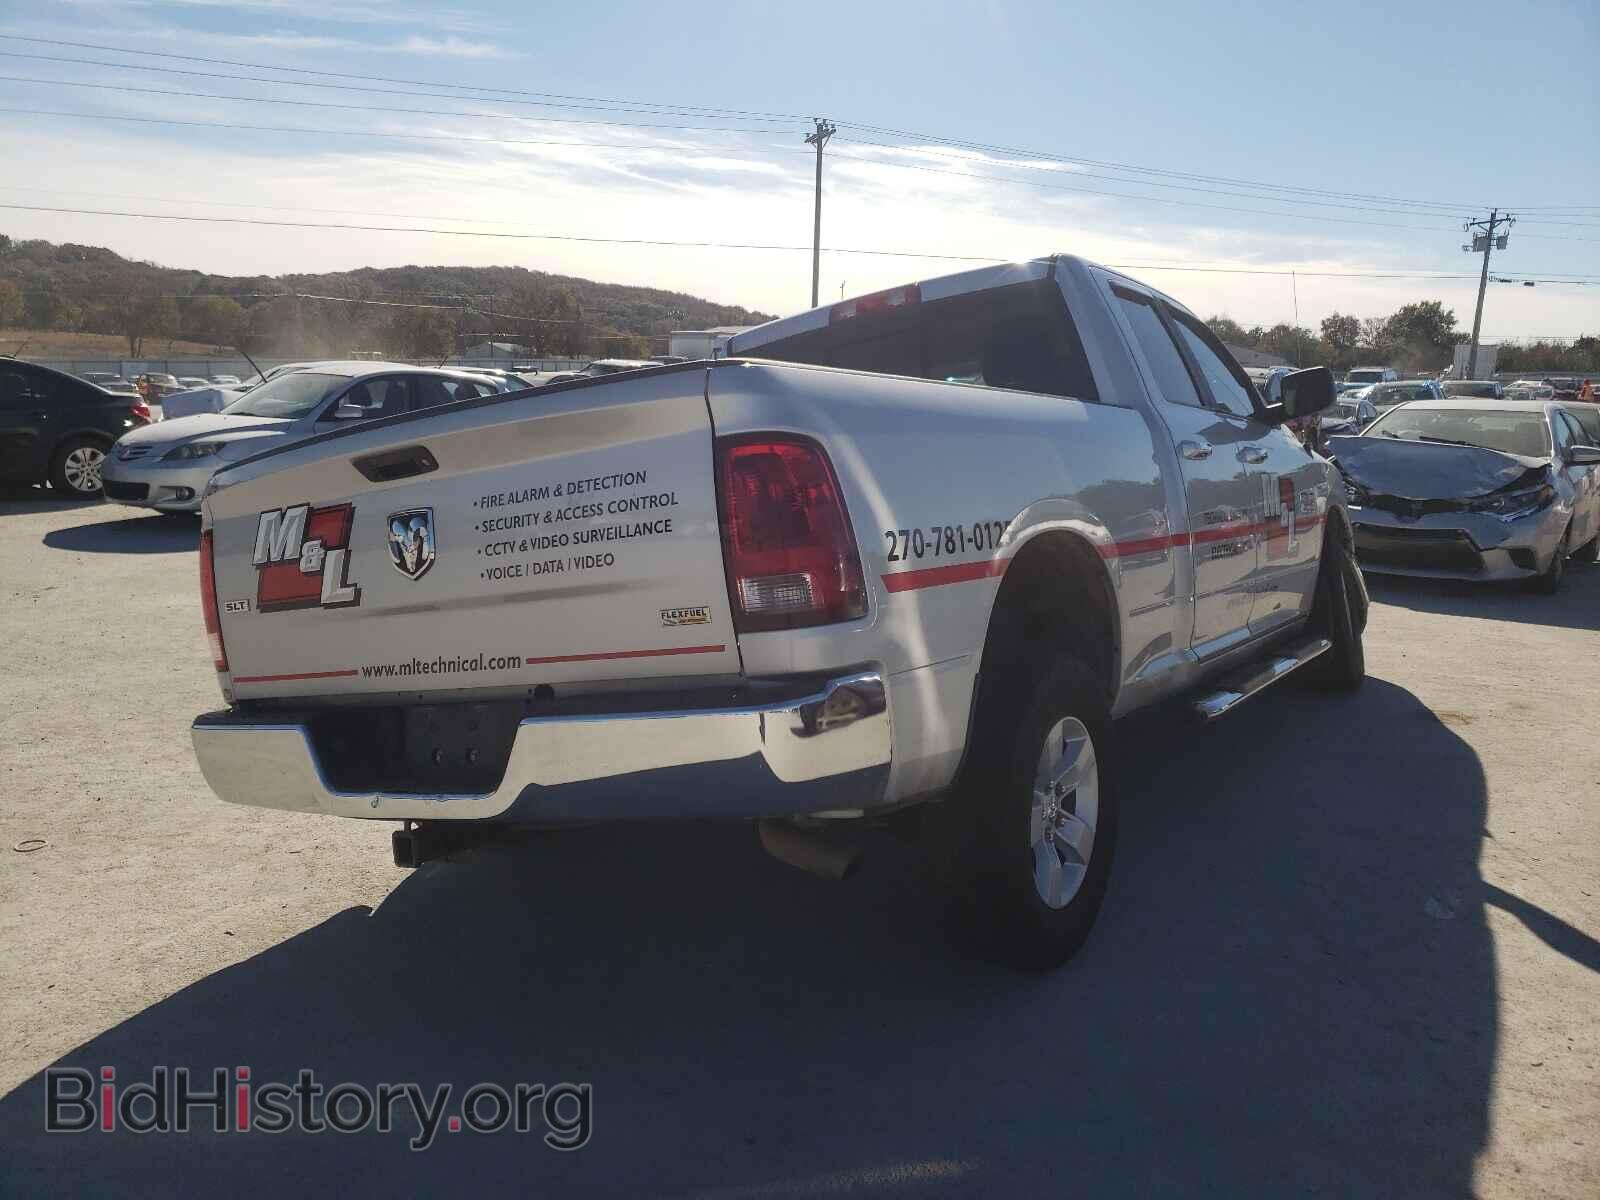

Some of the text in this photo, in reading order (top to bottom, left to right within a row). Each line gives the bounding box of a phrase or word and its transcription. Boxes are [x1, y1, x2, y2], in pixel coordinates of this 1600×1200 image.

[480, 470, 647, 509] FIRE ALARM & DETECTION
[482, 491, 679, 533] SECURITY & ACCESS CONTROL
[484, 518, 673, 557] CCTV & VIDEO SURVEILLANCE
[486, 564, 522, 581] VOICE
[533, 559, 564, 575] DATA
[574, 552, 615, 571] VIDEO
[225, 601, 246, 611] SLT
[661, 608, 707, 620] FLEXFUEL
[361, 653, 522, 678] www.mltechnical.com
